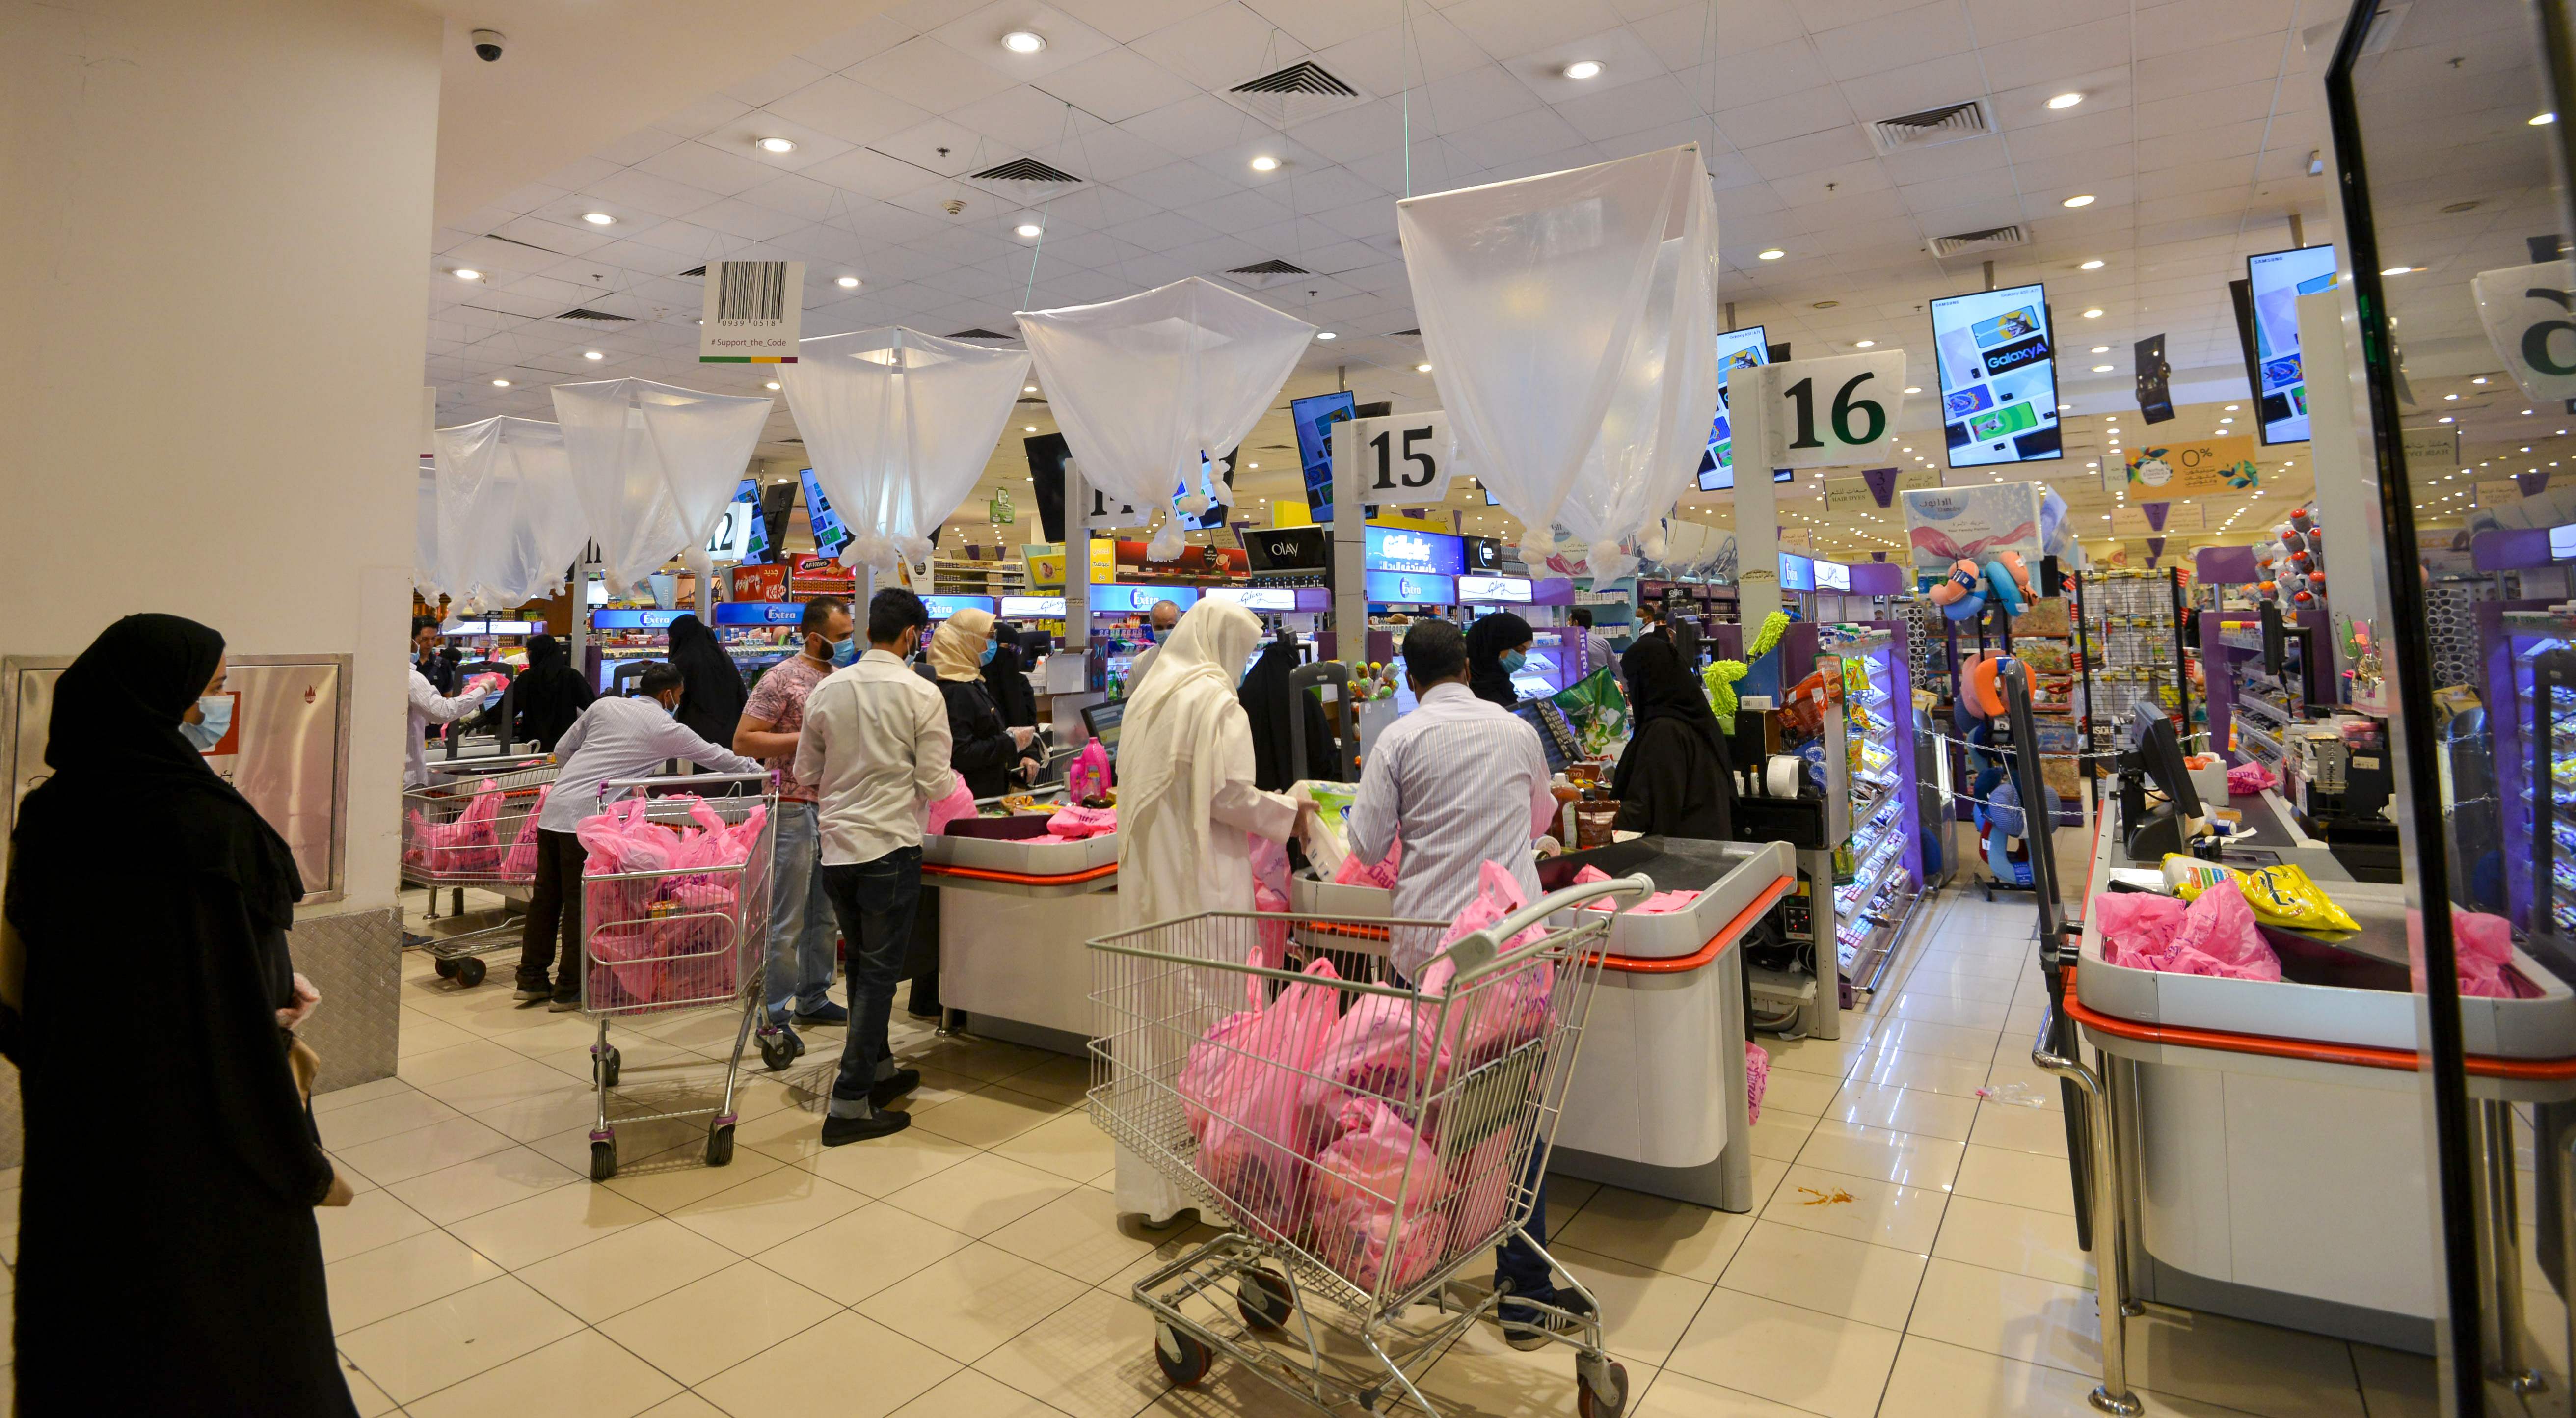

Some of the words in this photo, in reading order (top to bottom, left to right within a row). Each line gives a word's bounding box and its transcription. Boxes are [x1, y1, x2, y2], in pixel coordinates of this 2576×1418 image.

[717, 338, 786, 347] Support_the_Code
[1784, 371, 1887, 450] 16
[1369, 425, 1436, 490] 15
[1876, 471, 1885, 486] 3
[1919, 497, 1952, 508] الدانوب
[1271, 542, 1299, 557] OLAY
[768, 584, 786, 599] KitKat
[1401, 581, 1422, 595] Extra
[1240, 591, 1262, 605] Galaxy
[925, 601, 953, 614] Extra
[1040, 599, 1065, 612] Galaxy
[643, 614, 670, 625] Extra
[768, 609, 796, 619] Extra
